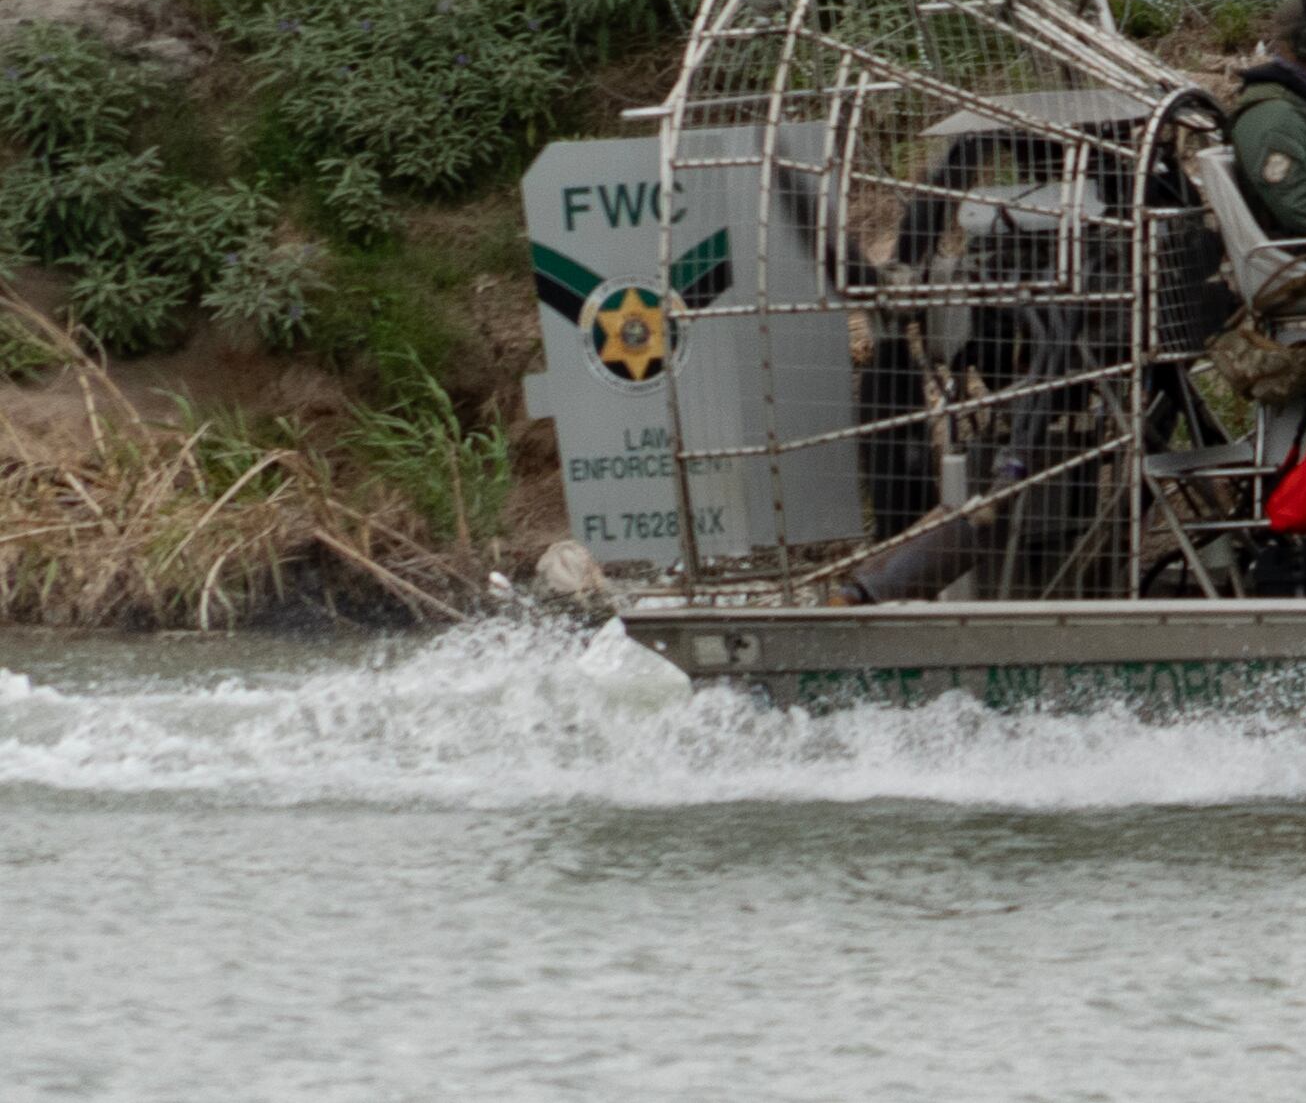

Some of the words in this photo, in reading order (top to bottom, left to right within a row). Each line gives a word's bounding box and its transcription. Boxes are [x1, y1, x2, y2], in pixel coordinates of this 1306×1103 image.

[564, 181, 688, 232] FWC
[584, 514, 617, 543] FL
[621, 510, 681, 539] 7628
